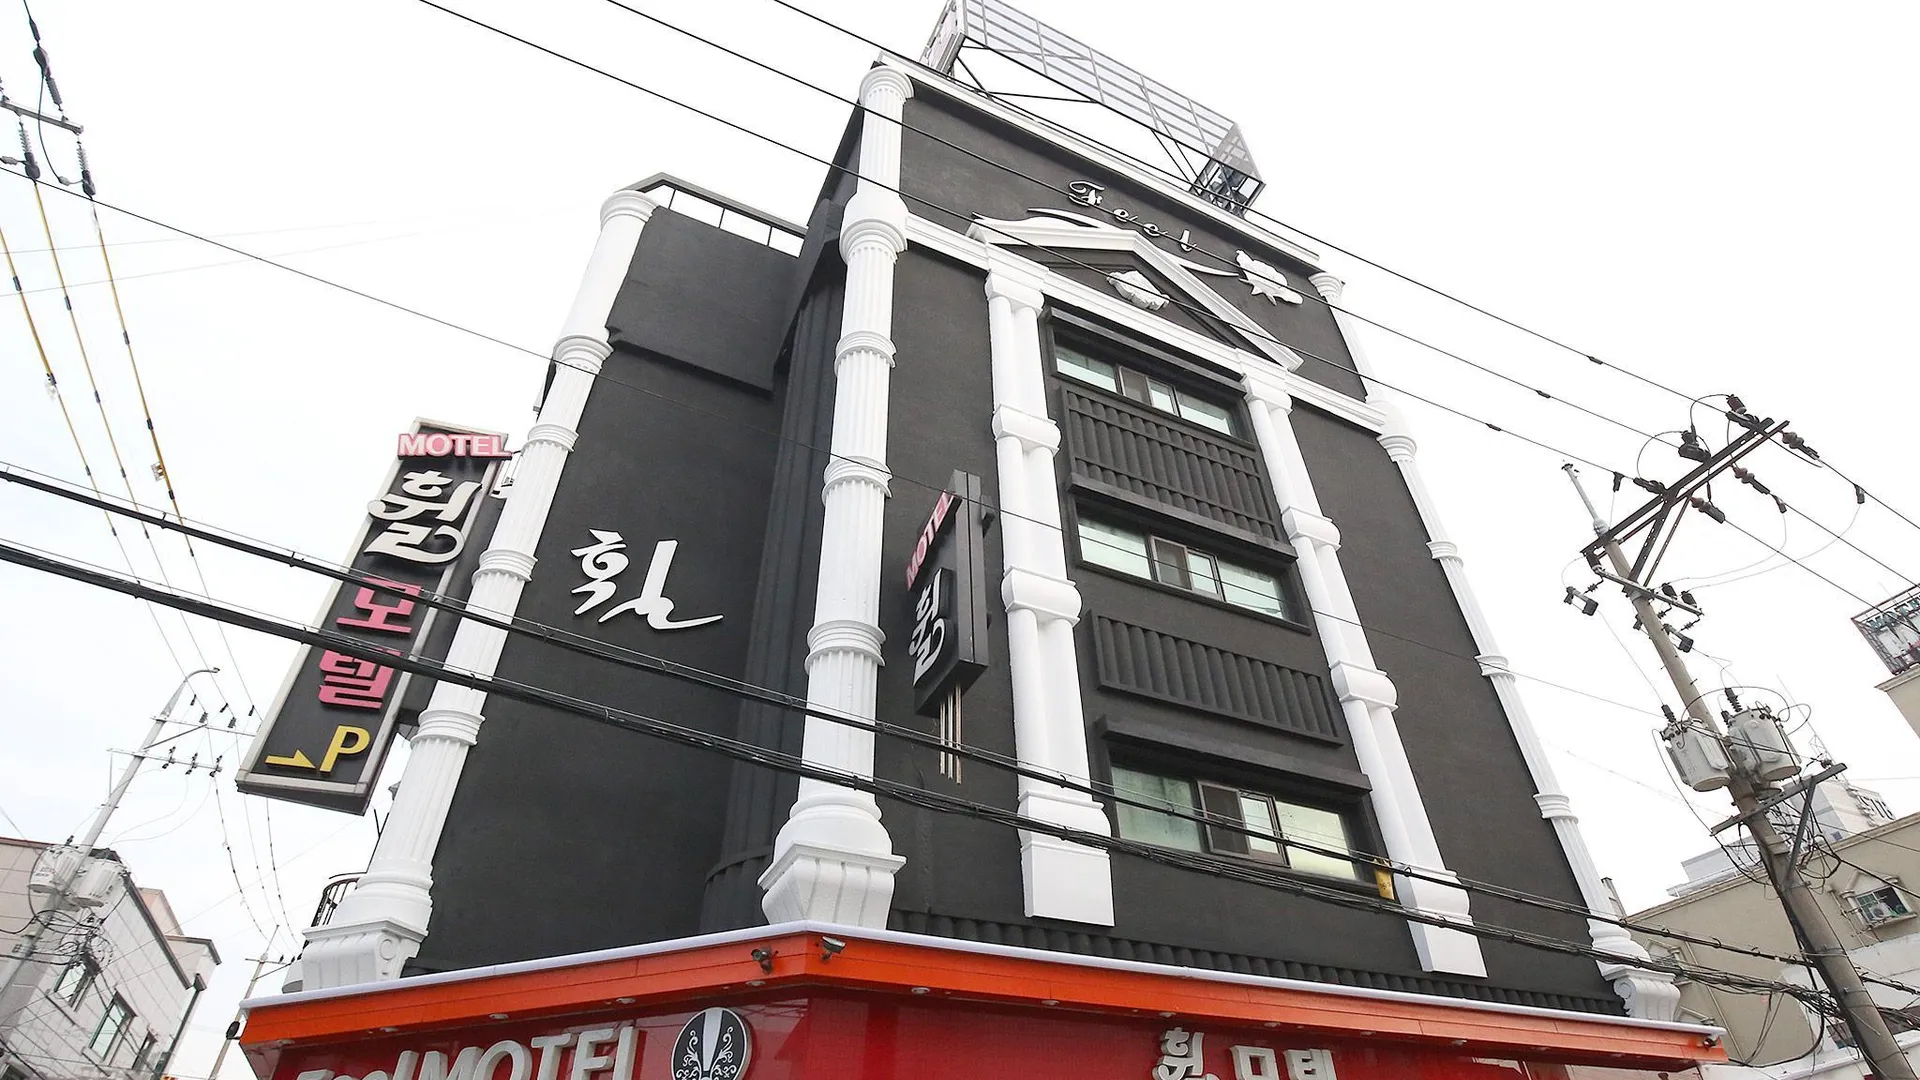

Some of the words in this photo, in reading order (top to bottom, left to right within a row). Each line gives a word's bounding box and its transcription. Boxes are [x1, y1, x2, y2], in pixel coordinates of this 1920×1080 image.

[1068, 180, 1198, 252] Feel
[398, 433, 513, 458] MOTEL
[906, 489, 955, 592] MOTEL
[319, 577, 420, 708] 모텔
[319, 725, 371, 774] P
